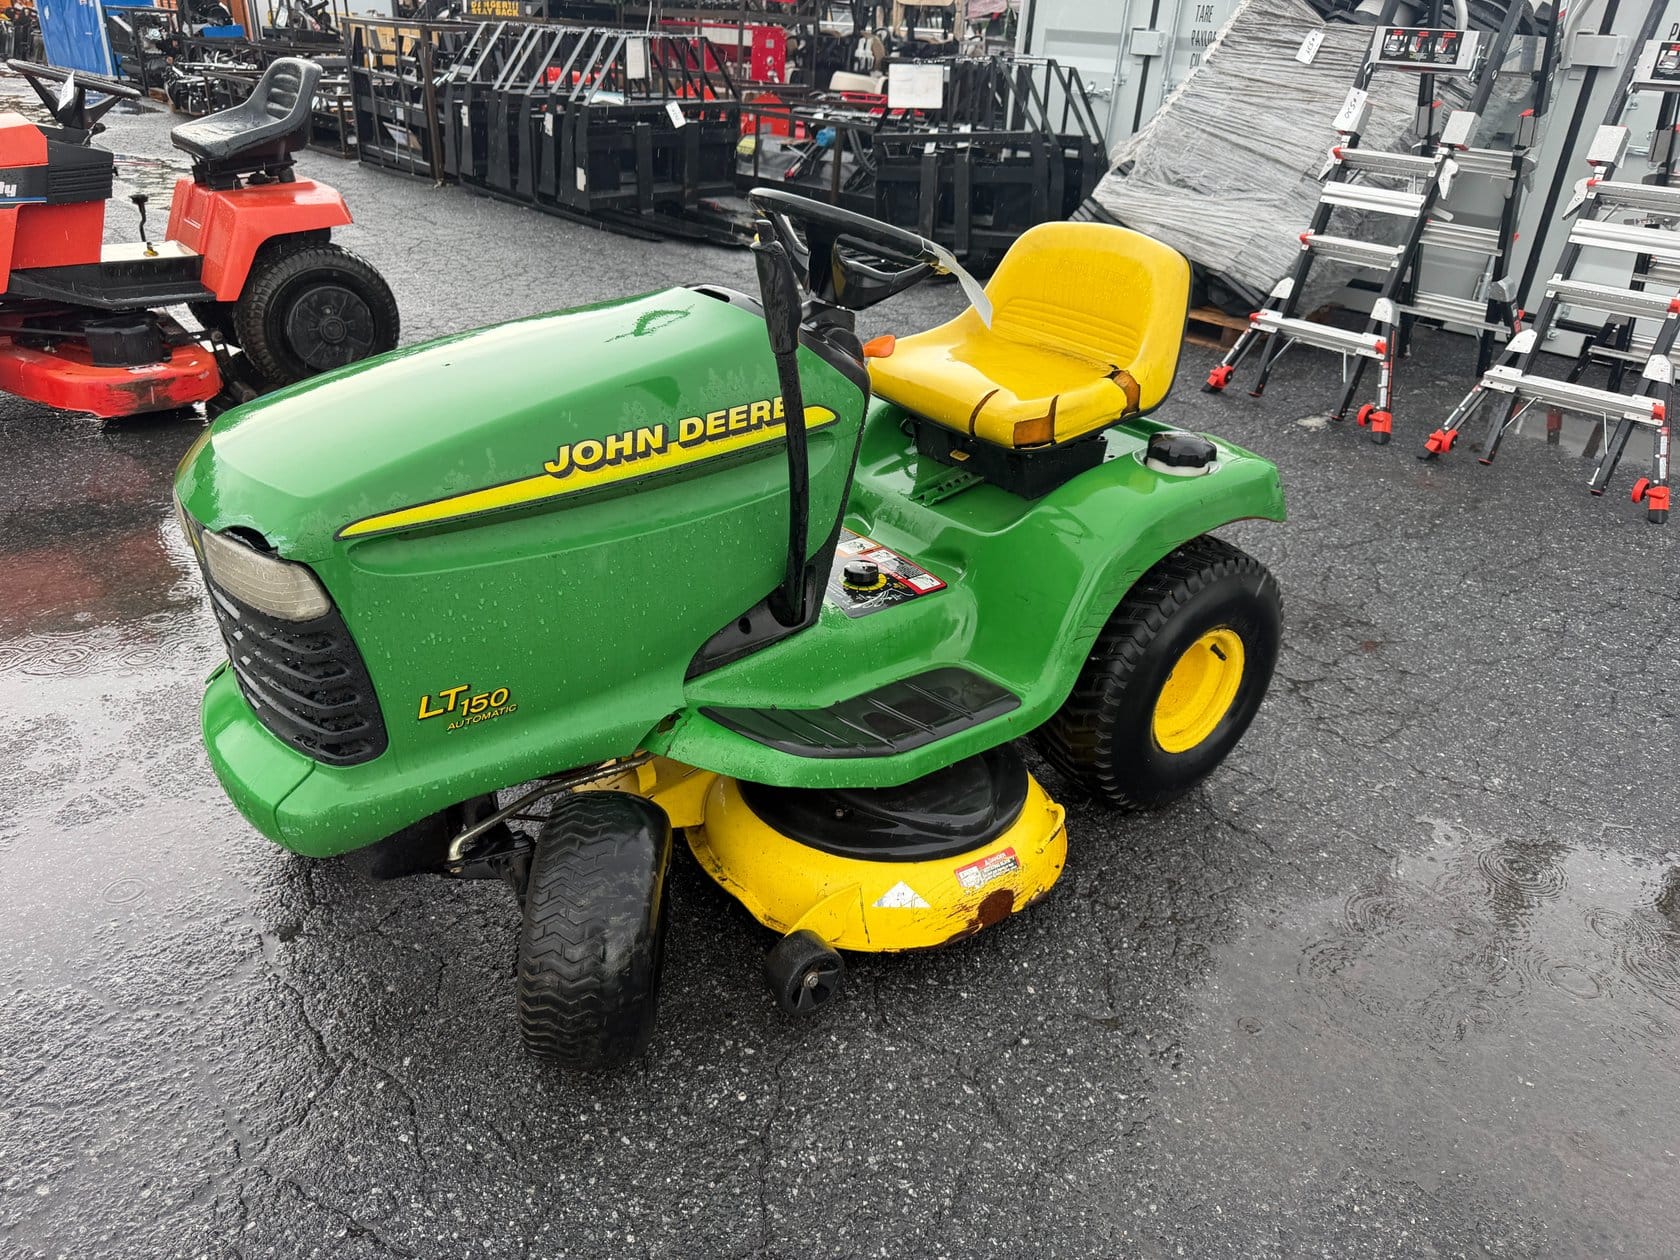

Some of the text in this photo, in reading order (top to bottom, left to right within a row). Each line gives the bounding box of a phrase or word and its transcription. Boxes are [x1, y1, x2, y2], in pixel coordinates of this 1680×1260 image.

[1195, 4, 1214, 22] TARE
[544, 424, 667, 476] JOHN
[446, 703, 518, 731] AUTOMATIC
